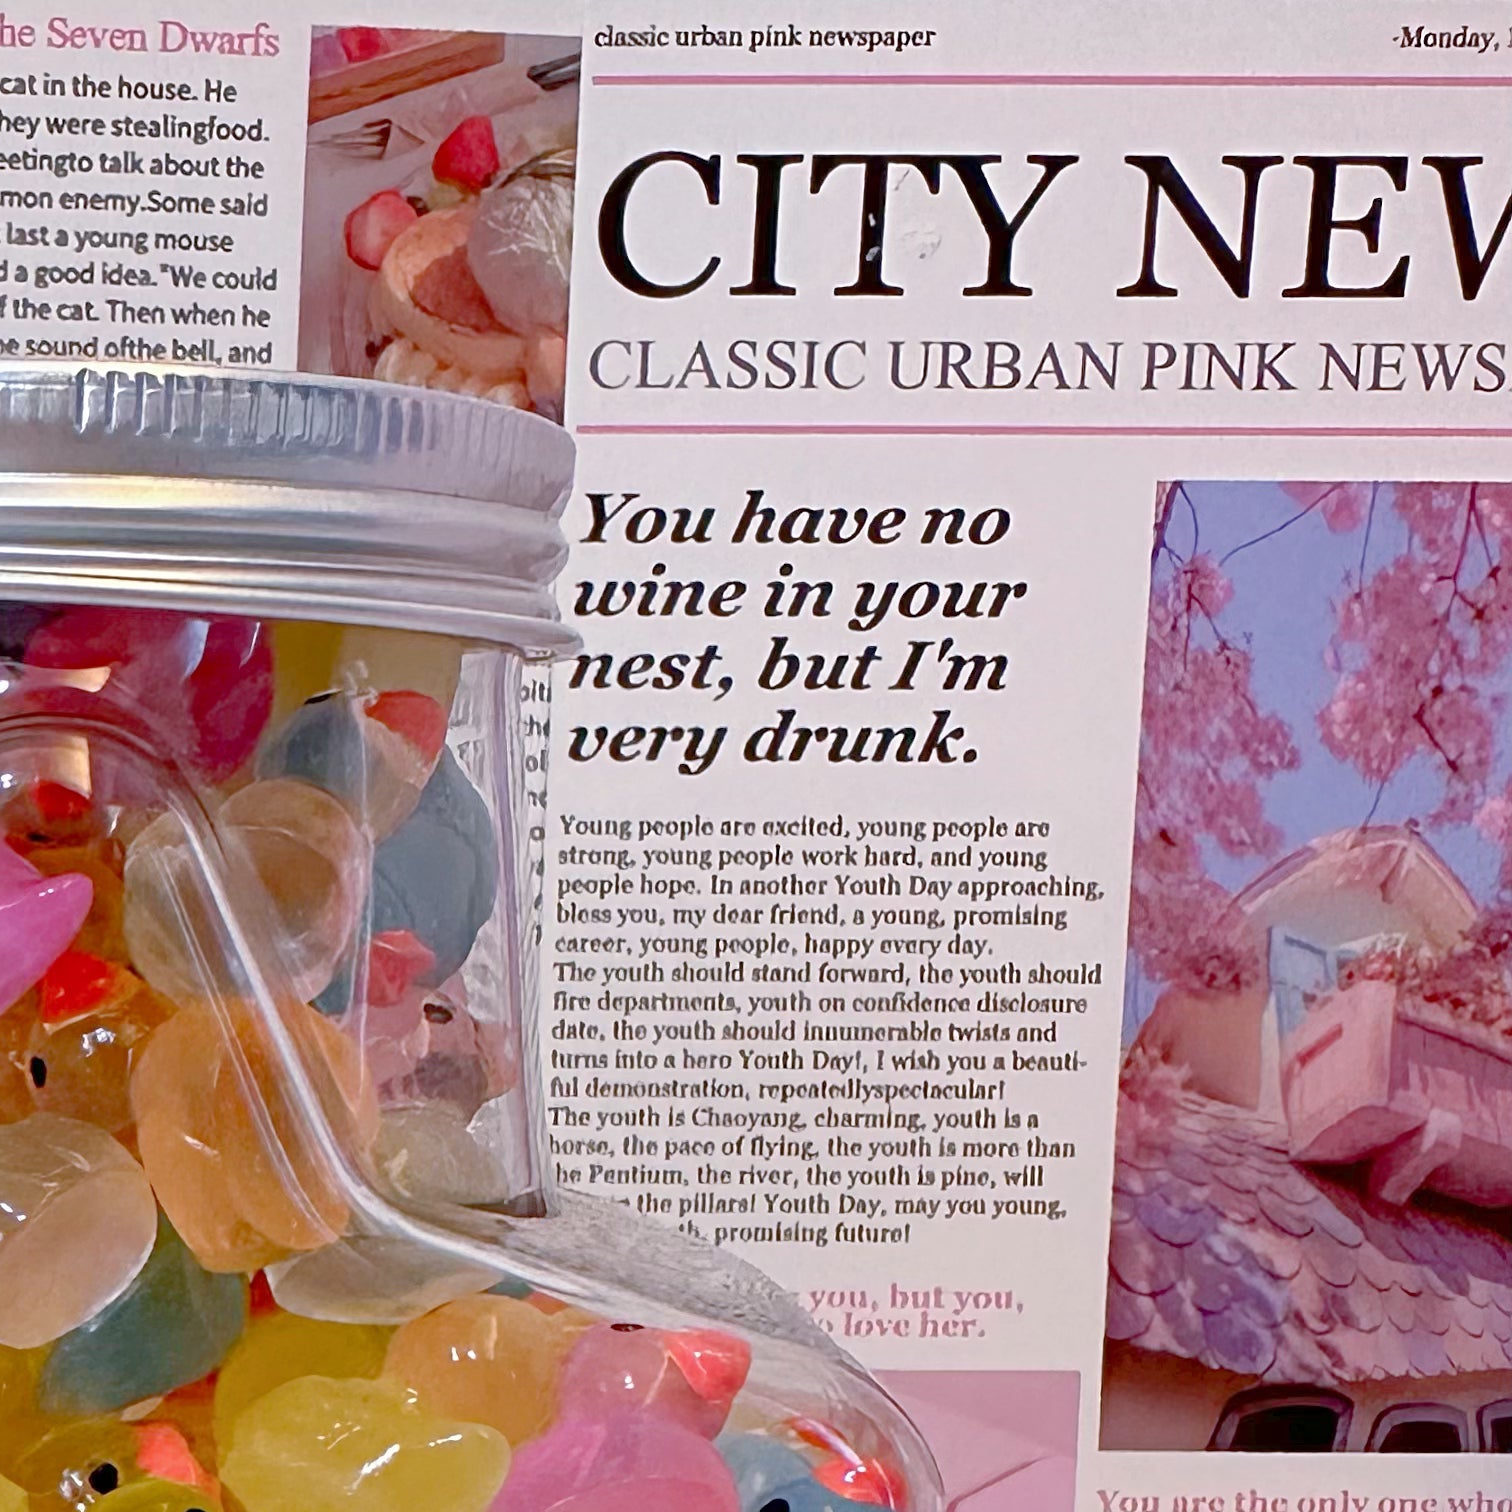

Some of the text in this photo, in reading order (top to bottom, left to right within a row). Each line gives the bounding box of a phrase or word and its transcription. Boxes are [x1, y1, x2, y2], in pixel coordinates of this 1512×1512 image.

[46, 17, 148, 51] Seven
[157, 20, 279, 56] Dwarfs
[593, 24, 936, 52] classic urban pink newspaper
[1392, 25, 1500, 53] -Monday,
[42, 71, 65, 96] in
[71, 73, 112, 97] the
[117, 74, 198, 101] house.
[204, 78, 237, 102] He
[44, 116, 106, 135] were
[98, 150, 144, 174] talk
[149, 152, 220, 176] about
[225, 155, 264, 178] the
[597, 150, 1079, 298] CITY
[588, 339, 1512, 392] CLASSIC URBAN PINK NEWS
[578, 489, 1010, 544] You have no
[574, 562, 1027, 631] wine in your
[568, 636, 1008, 702] nest, but I'm
[567, 709, 977, 775] very drunk.
[559, 814, 1049, 841] Young people are excited, young people are
[557, 872, 1104, 901] people hope. In another Youth Day approaching,
[809, 1282, 1025, 1315] you, but you,
[843, 1311, 909, 1337] love
[918, 1312, 985, 1337] her.
